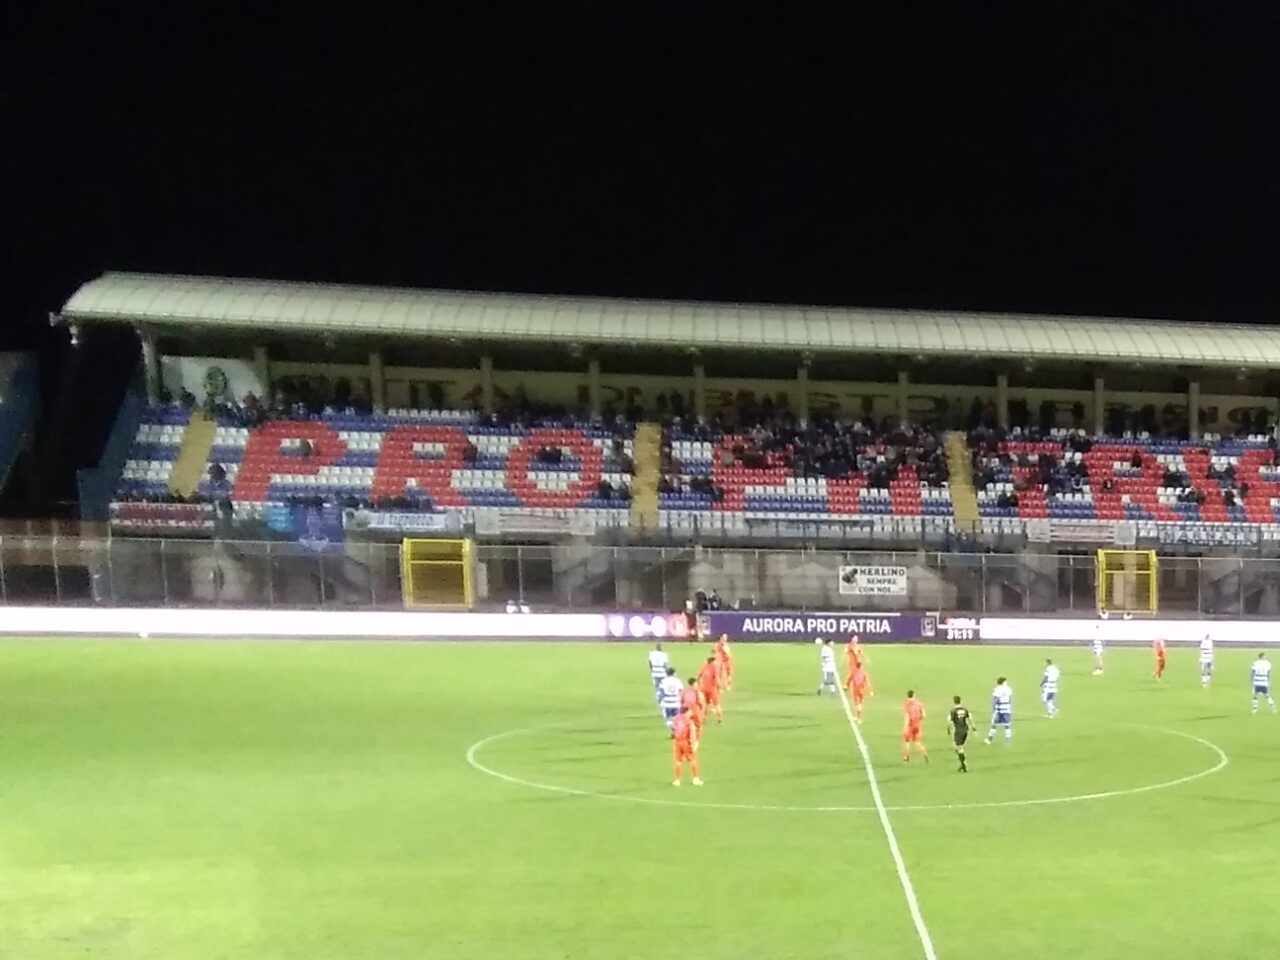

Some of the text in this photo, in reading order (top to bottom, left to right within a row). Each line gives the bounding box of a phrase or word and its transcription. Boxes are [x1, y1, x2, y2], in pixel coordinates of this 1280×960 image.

[232, 420, 604, 508] PRO
[859, 568, 906, 577] MERLINO
[742, 618, 891, 633] AURORA PRO PATRIA
